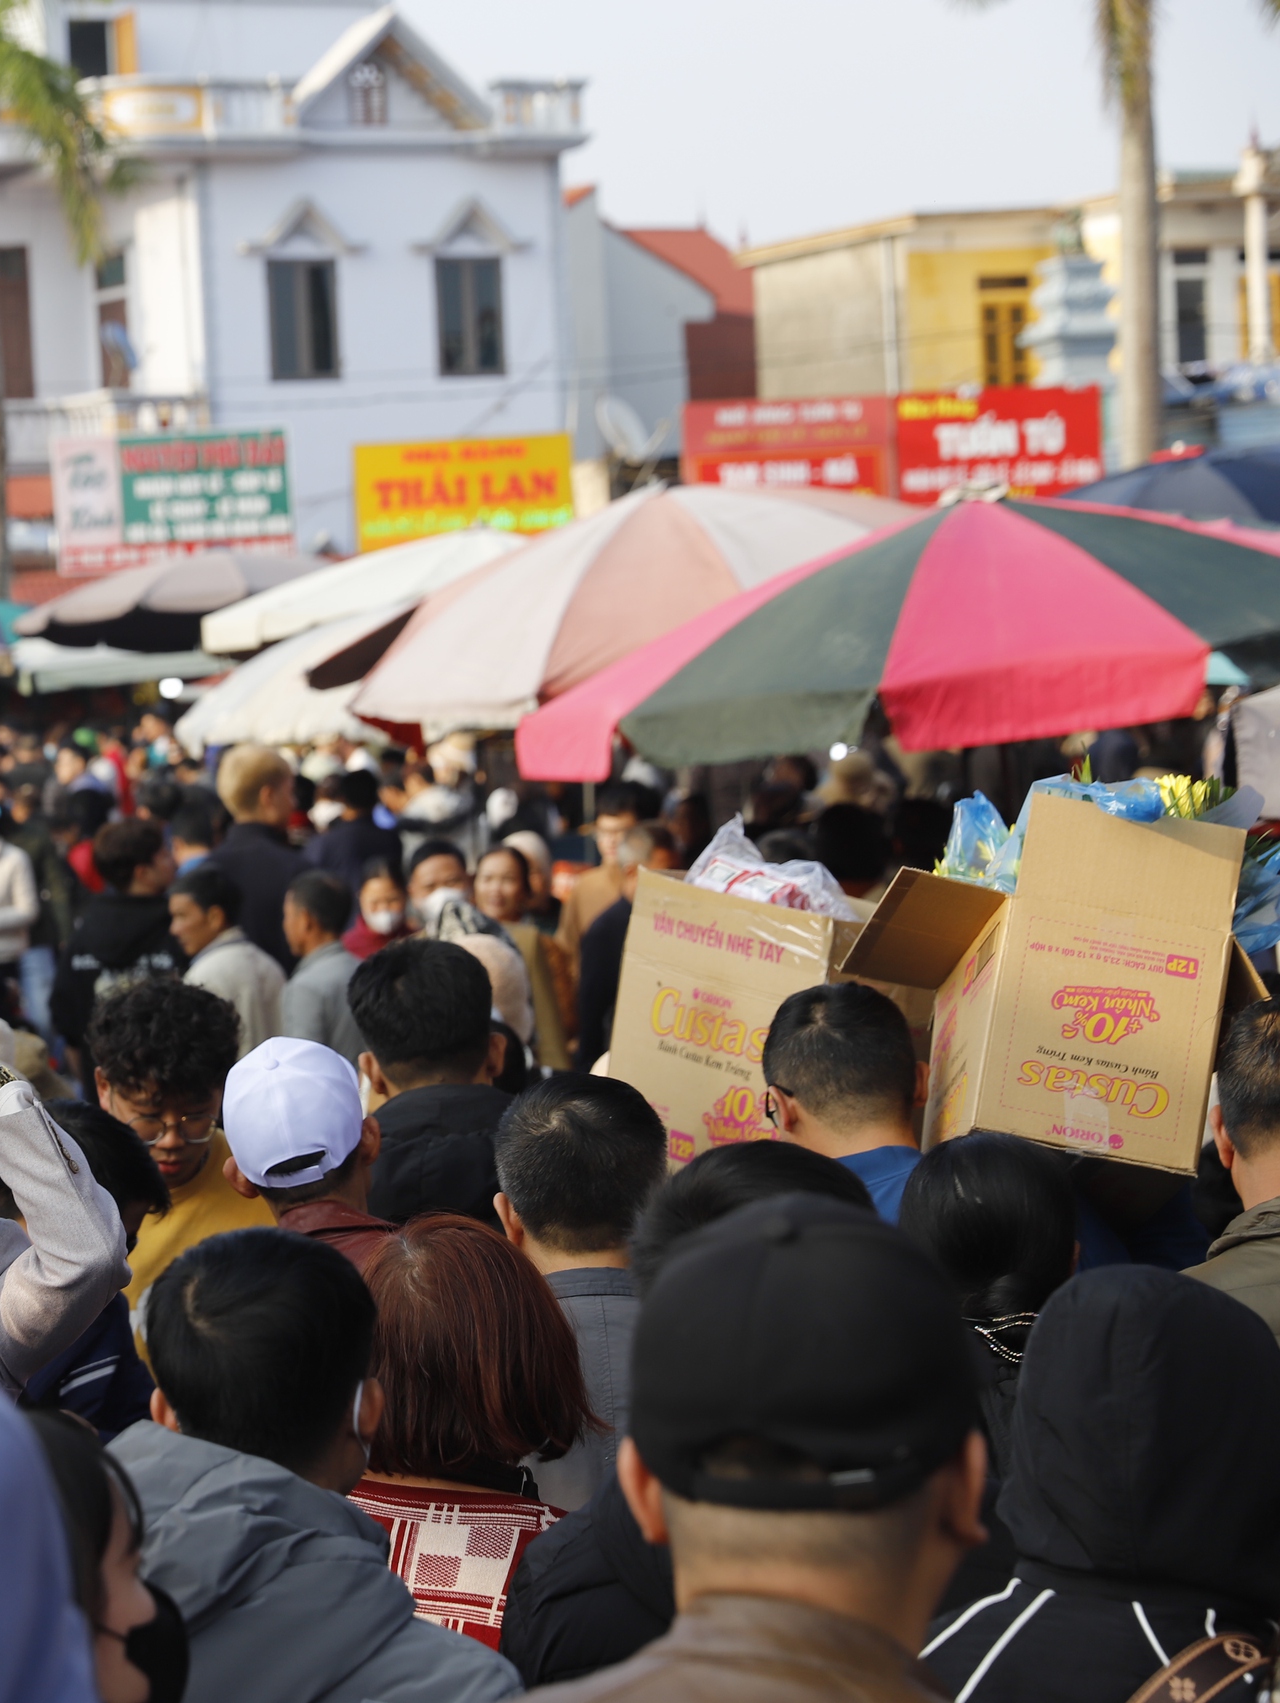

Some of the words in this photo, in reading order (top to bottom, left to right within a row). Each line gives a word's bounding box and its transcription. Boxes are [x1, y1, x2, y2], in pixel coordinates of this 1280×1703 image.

[374, 468, 467, 509] THÁI
[479, 470, 558, 503] LAN
[653, 911, 675, 938] VẬN
[676, 920, 724, 949] CHUYỂN
[726, 933, 755, 961] NHẸ
[758, 941, 785, 963] TAY
[1030, 941, 1046, 952] HỘP
[1062, 948, 1075, 957] GÓI
[1077, 951, 1086, 959] 12
[1103, 955, 1121, 965] 23,5
[1123, 960, 1146, 970] CÁCH:
[1148, 964, 1164, 974] QUY
[1167, 958, 1196, 975] 12P
[1053, 991, 1100, 1012] Kem
[1102, 997, 1153, 1018] Nhân
[650, 986, 770, 1064] Custas
[1036, 1045, 1067, 1061] Trứng
[1071, 1053, 1094, 1067] Kem
[1096, 1059, 1129, 1074] Custas
[1132, 1065, 1159, 1080] Bánh
[1017, 1060, 1170, 1119] Custas
[1051, 1124, 1103, 1143] ORION
